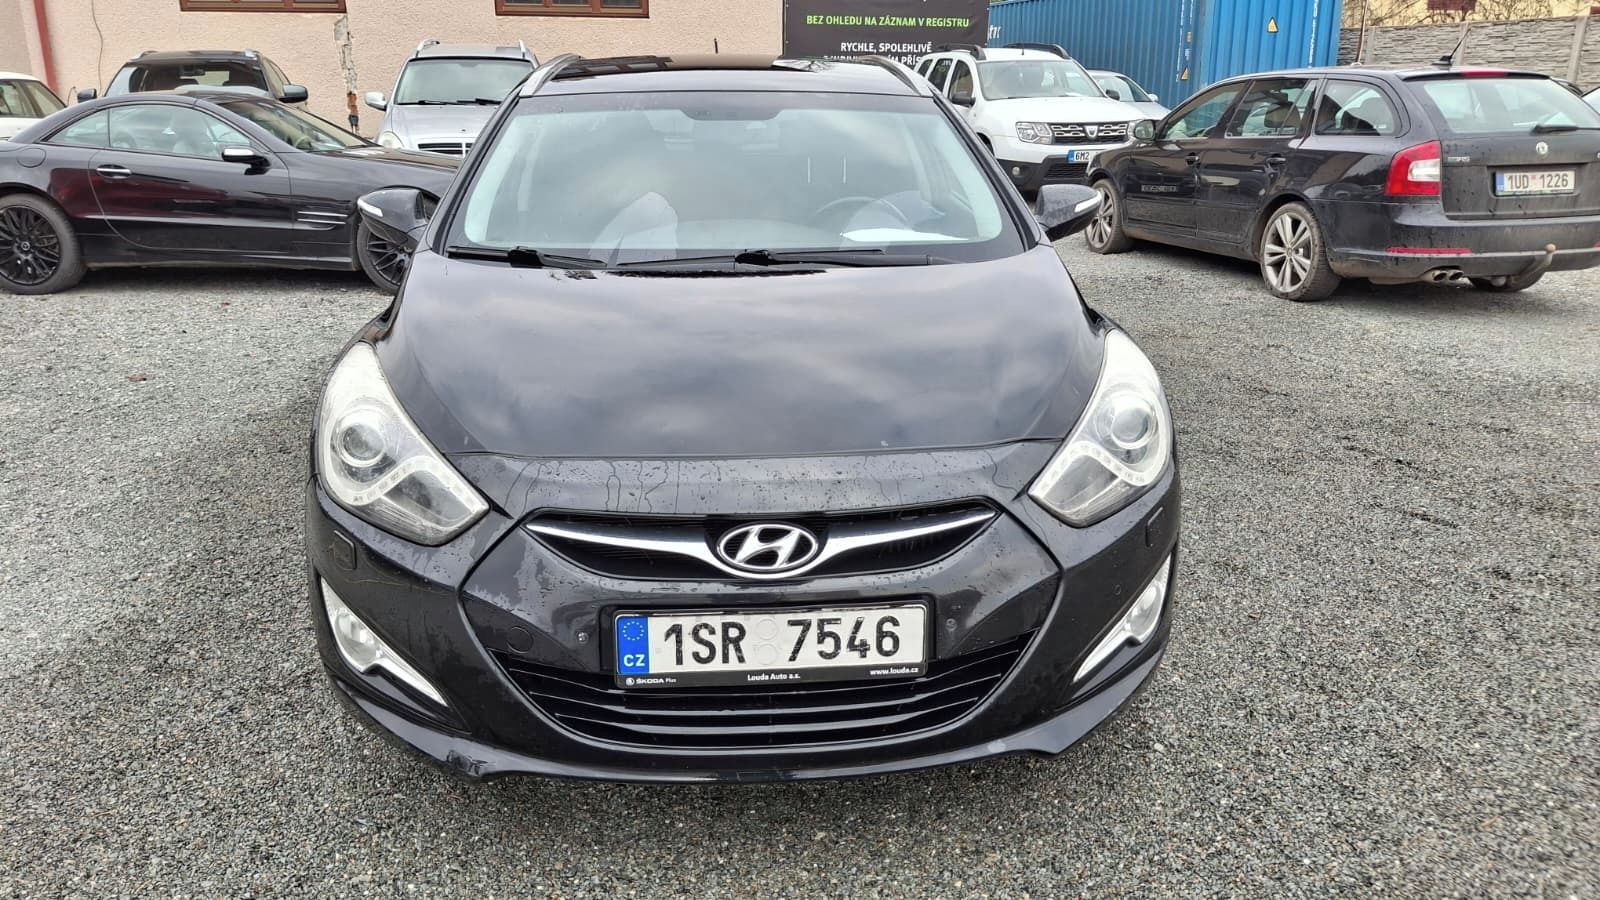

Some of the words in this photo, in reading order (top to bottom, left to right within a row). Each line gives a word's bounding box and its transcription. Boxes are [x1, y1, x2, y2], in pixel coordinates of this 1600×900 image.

[806, 15, 824, 25] BEZ
[825, 15, 862, 26] OHLEDU
[864, 16, 877, 26] NA
[878, 14, 917, 27] ZÁZNAM
[918, 17, 925, 27] V
[926, 17, 970, 28] REGISTRU
[840, 42, 877, 53] RYCHLE,
[1507, 174, 1530, 190] 1UD
[1539, 173, 1569, 189] 1226
[663, 620, 747, 666] 1SR
[786, 614, 901, 662] 7546
[623, 654, 646, 668] CZ
[747, 673, 769, 681] Louda
[870, 667, 918, 675] www.louda.cz
